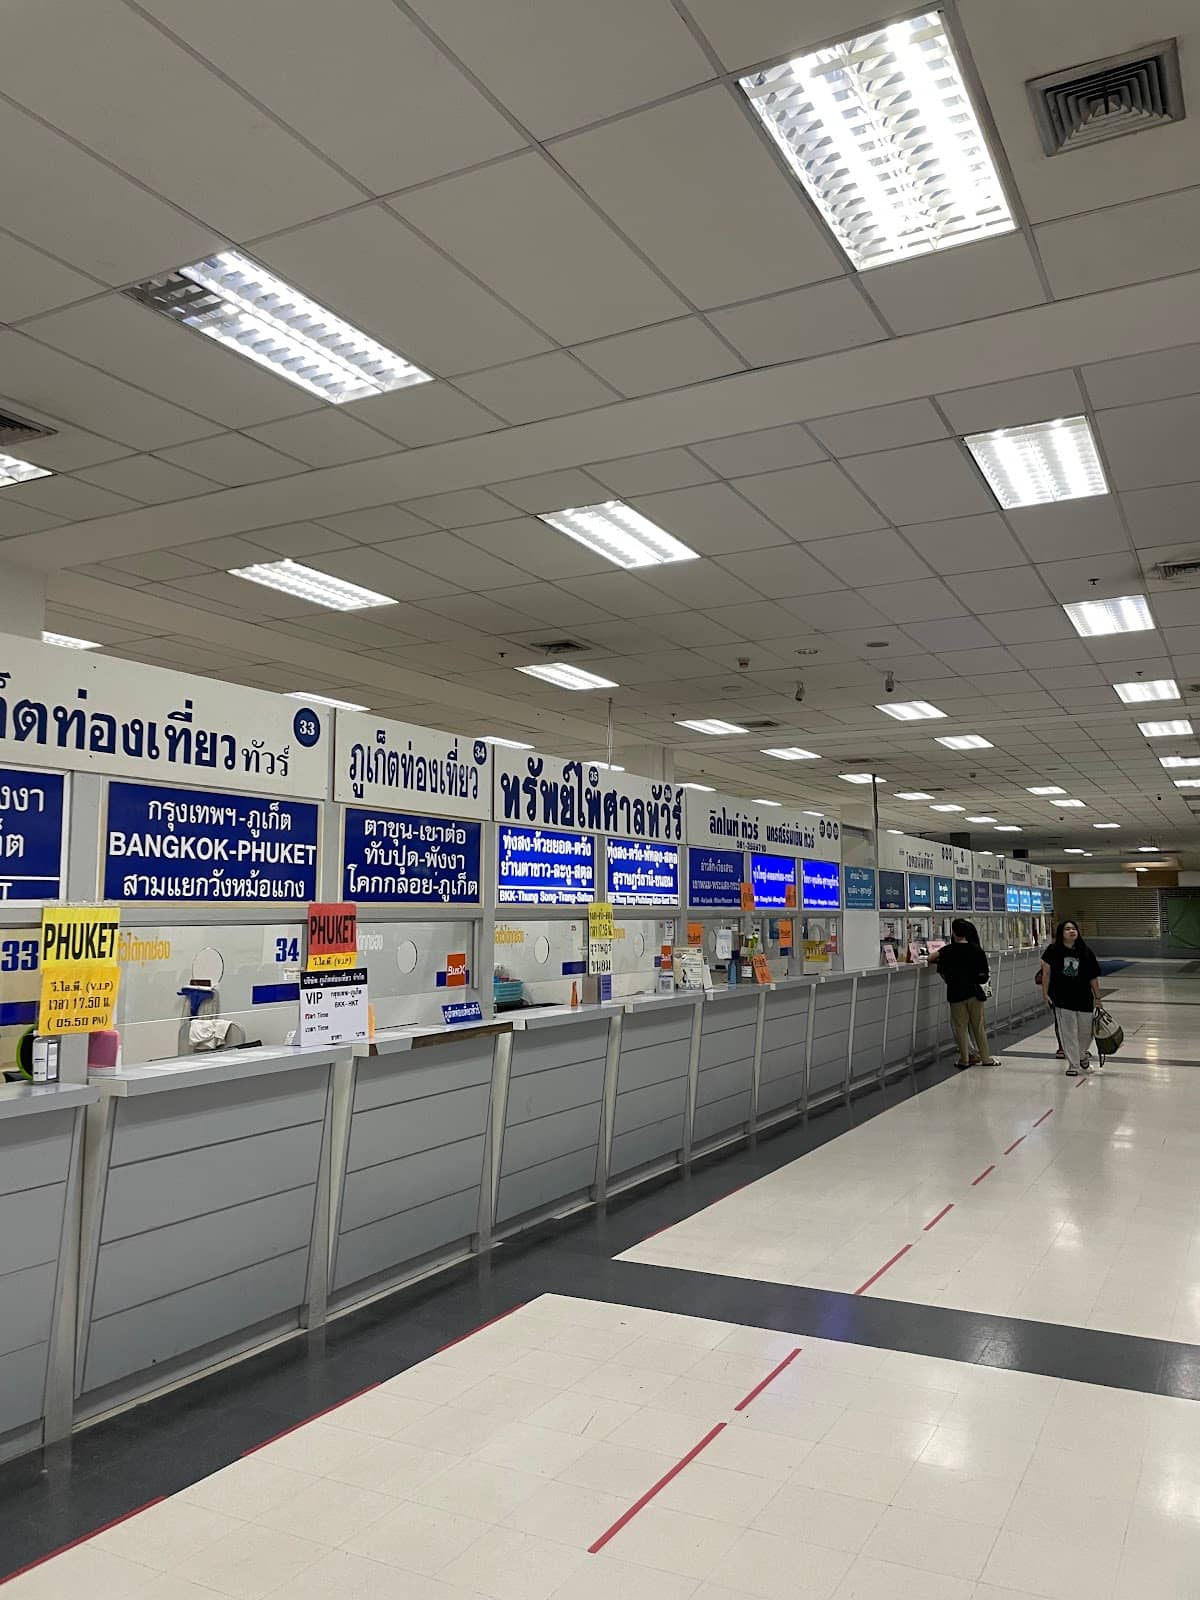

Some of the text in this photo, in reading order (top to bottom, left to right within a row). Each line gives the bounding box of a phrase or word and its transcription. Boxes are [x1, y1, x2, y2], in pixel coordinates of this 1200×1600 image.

[241, 739, 290, 777] ทัวร์
[349, 729, 479, 800] ภูเก็ตท่องเที่ยว
[500, 756, 684, 840] ทรัพย์ไพศาลทัวร์
[148, 800, 292, 838] กรุงเทพฯ-ภูเก็ต
[364, 818, 466, 847] ตาขุน-เขาต่อ
[109, 831, 317, 865] BANGKOK-PHUKET
[364, 841, 465, 875] ทับปุด-พังงา
[123, 869, 305, 898] สามแยกวังหม้อแกง
[43, 922, 119, 961] PHUKET
[310, 915, 357, 945] PHUKET
[1, 940, 39, 971] 33
[275, 937, 300, 962] 34
[73, 997, 101, 1010] 17.50
[305, 991, 323, 1005] VIP
[56, 1016, 89, 1028] 05.50
